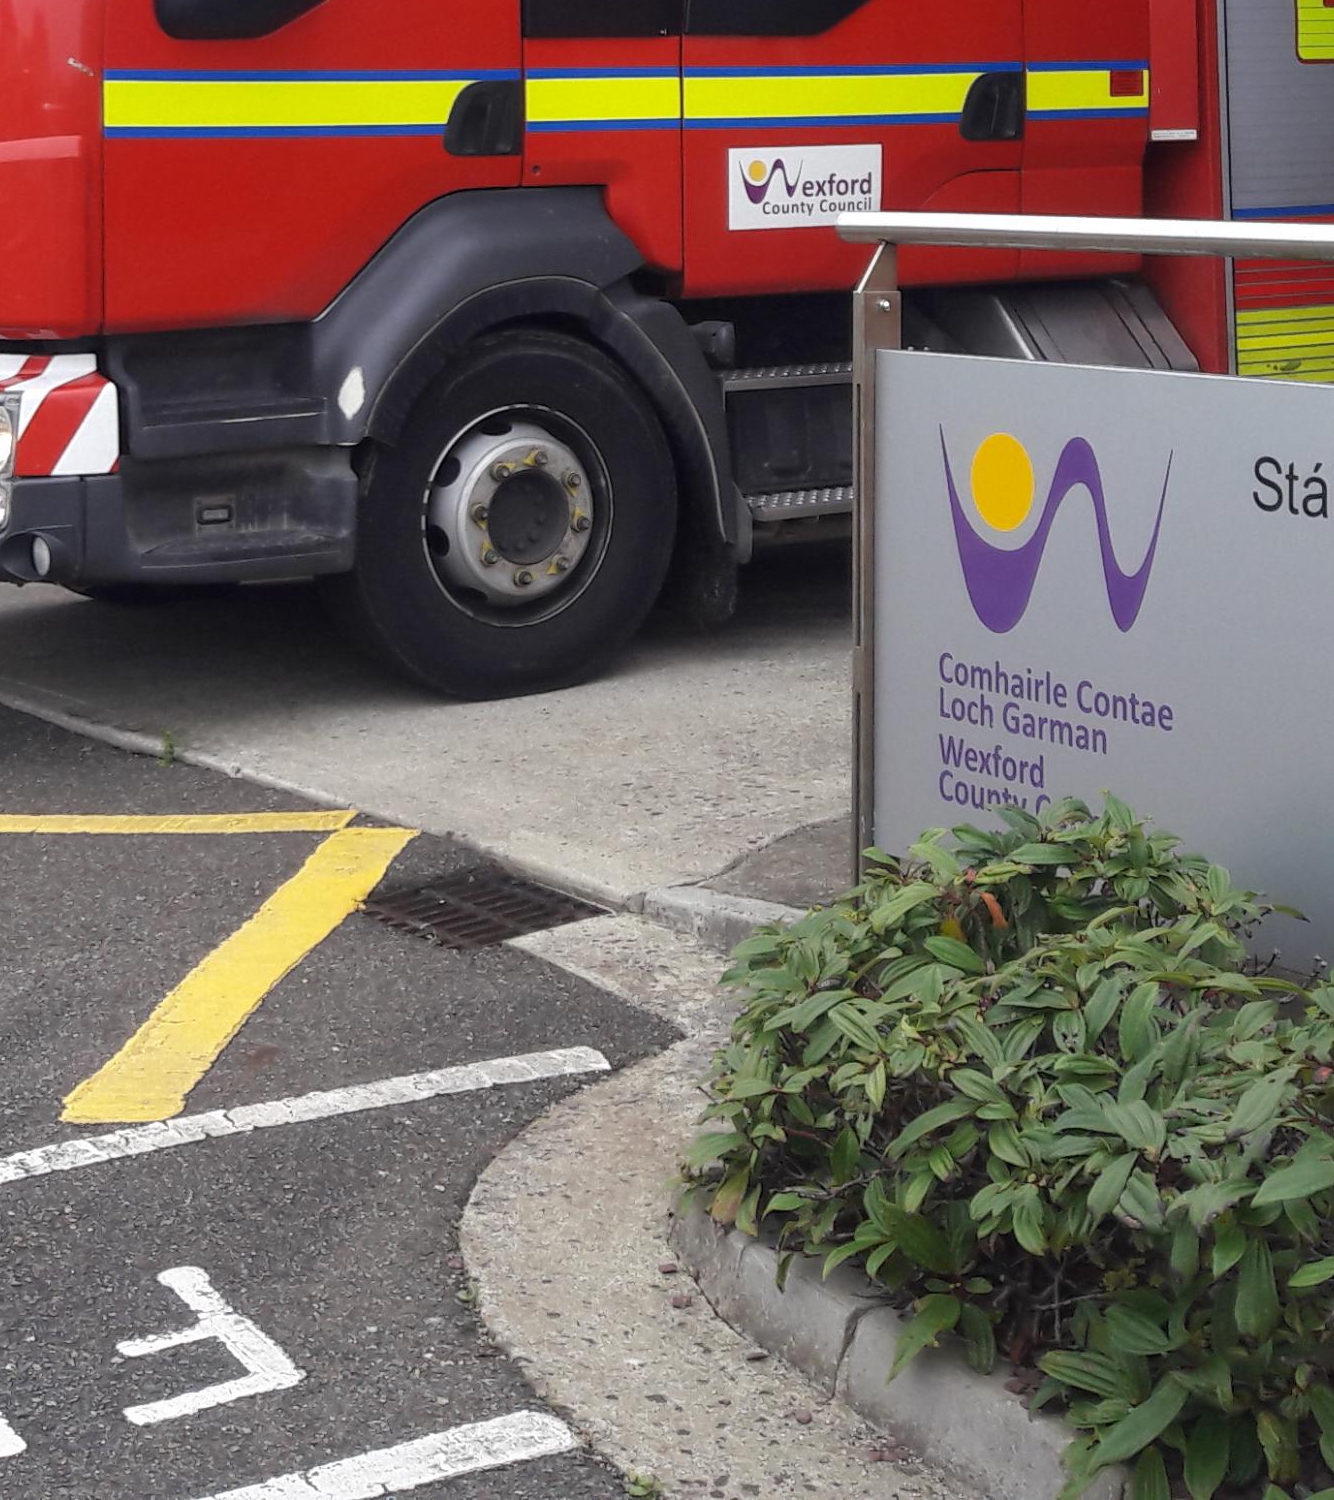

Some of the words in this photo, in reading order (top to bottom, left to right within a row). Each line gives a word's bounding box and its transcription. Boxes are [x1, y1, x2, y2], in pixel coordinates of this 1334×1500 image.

[762, 201, 814, 216] County
[819, 197, 872, 213] Council
[939, 652, 1067, 708] Comhairle
[1077, 680, 1173, 731] Contae
[939, 687, 994, 729] Loch
[1002, 701, 1107, 754] Garman
[939, 733, 1044, 788] Wexford
